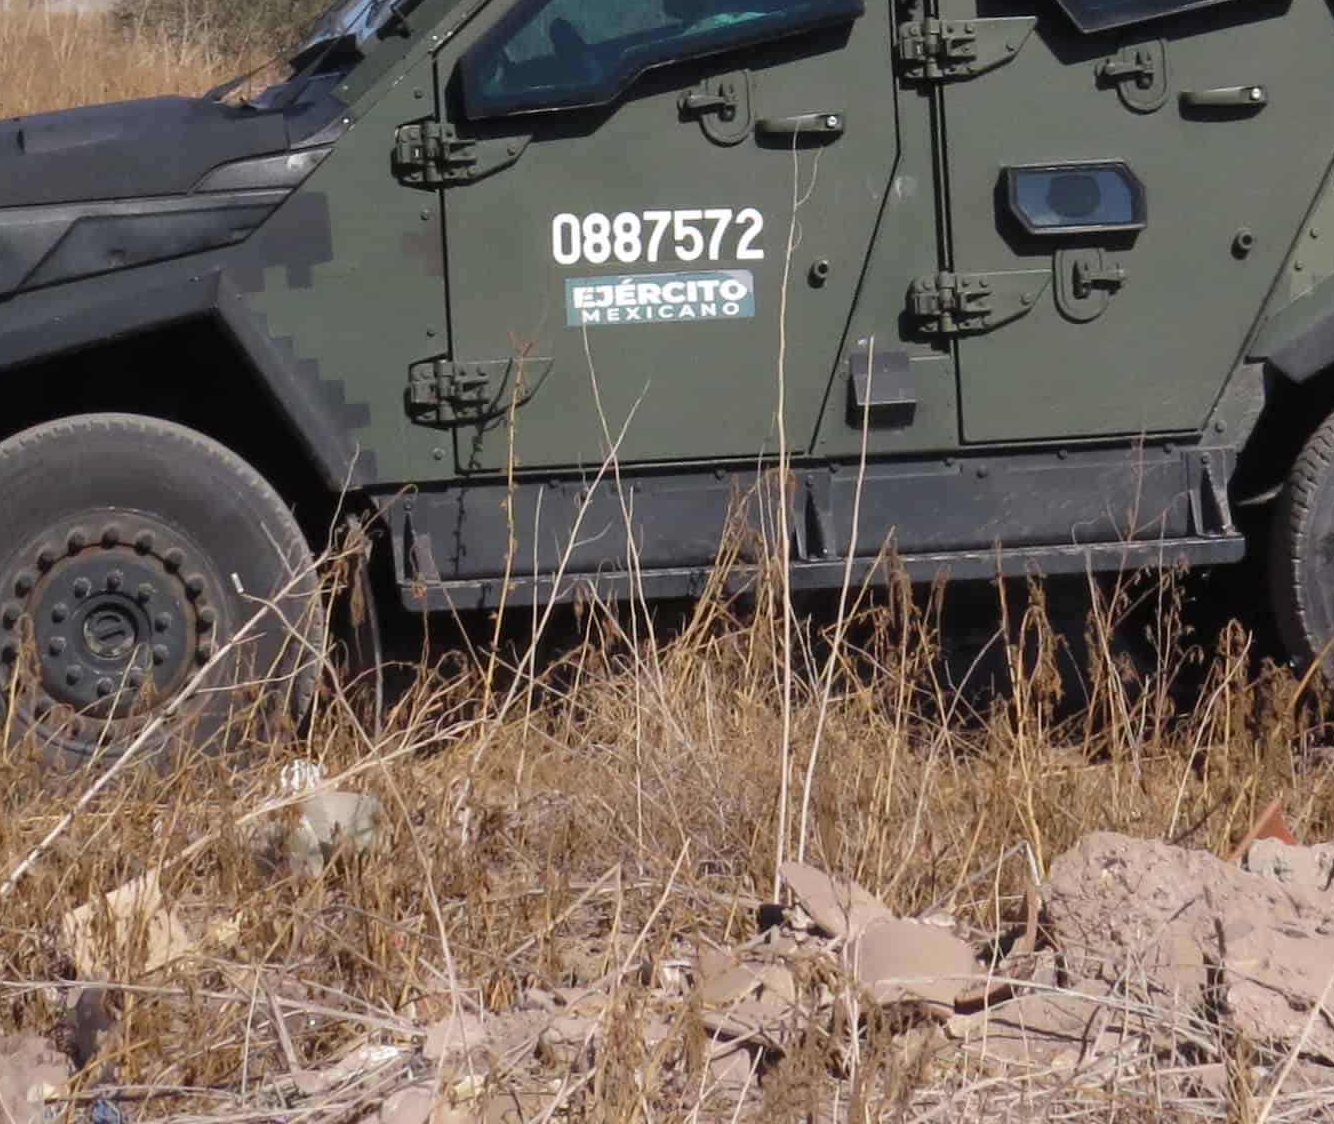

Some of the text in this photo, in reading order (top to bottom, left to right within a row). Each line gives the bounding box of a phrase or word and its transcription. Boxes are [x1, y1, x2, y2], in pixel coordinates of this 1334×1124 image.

[552, 208, 765, 265] 0887572
[573, 278, 747, 308] EJÉRCITO
[581, 302, 740, 322] MEXICANO
